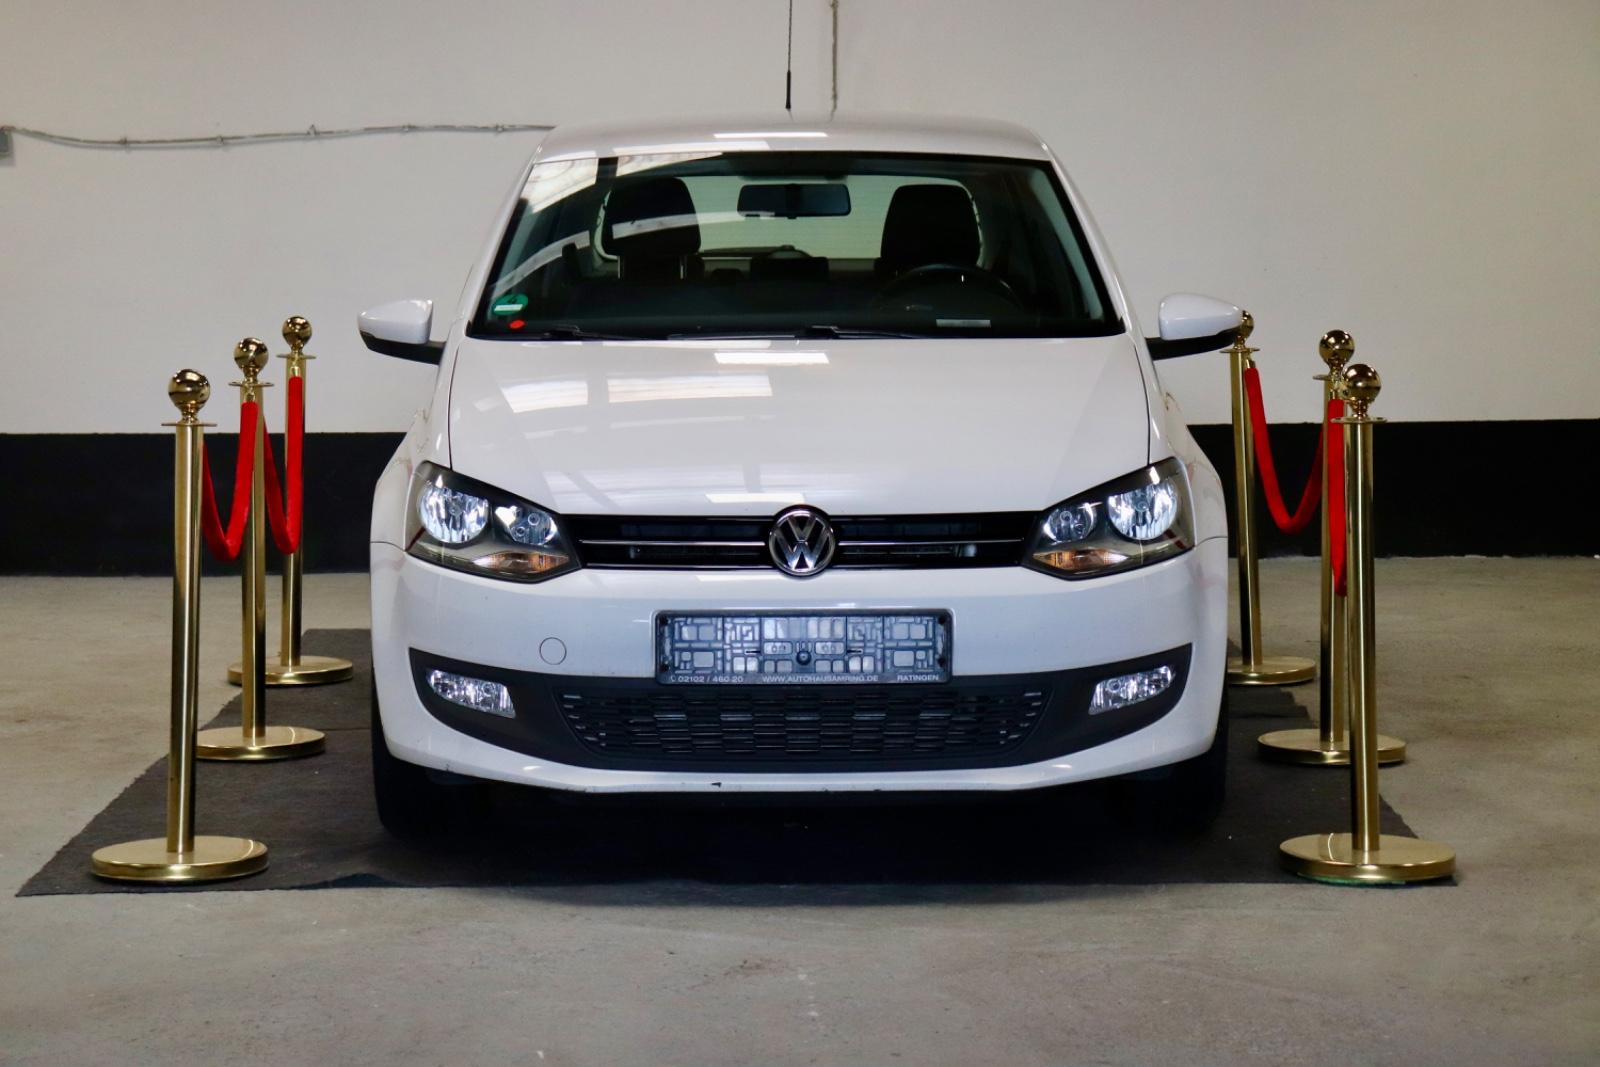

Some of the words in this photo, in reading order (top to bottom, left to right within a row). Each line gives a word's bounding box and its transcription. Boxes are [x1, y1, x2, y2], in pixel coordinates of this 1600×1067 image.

[770, 510, 834, 574] VW
[677, 675, 705, 683] 02102
[897, 674, 939, 682] RATINGEN
